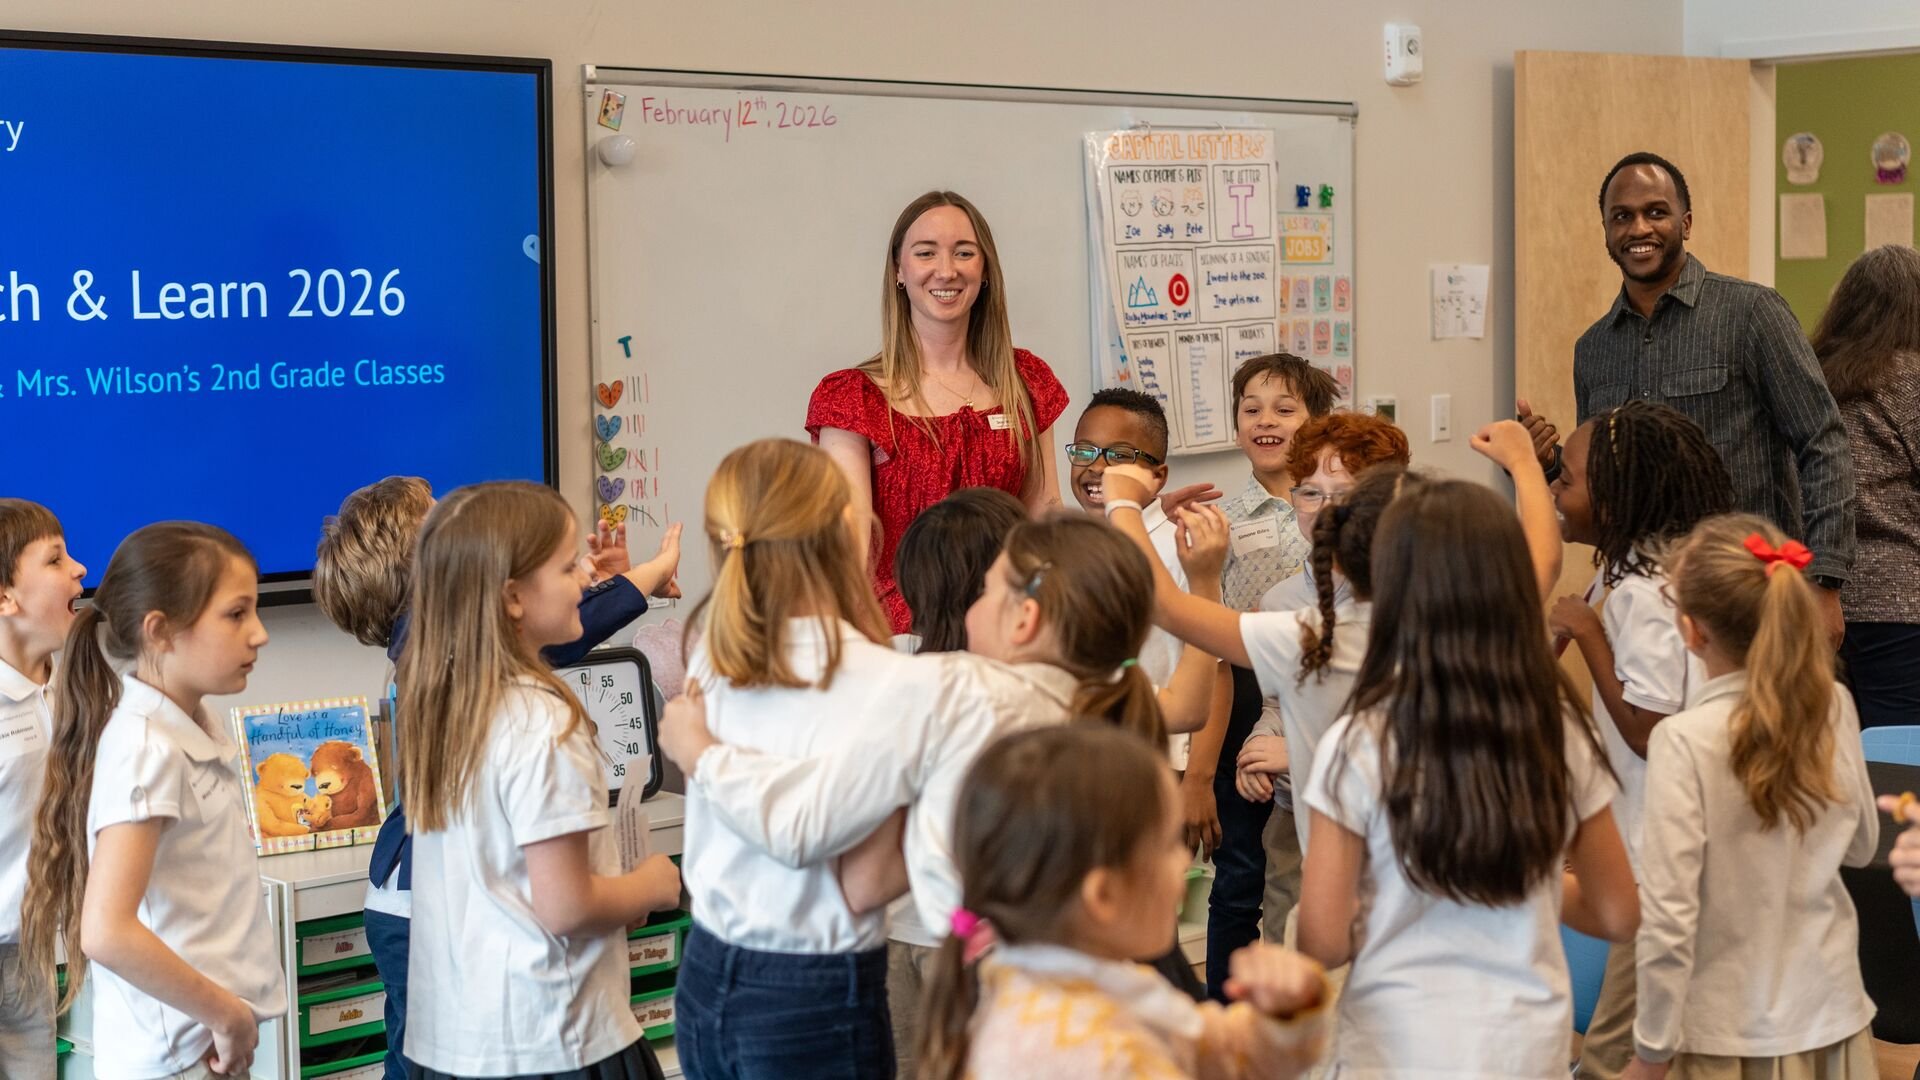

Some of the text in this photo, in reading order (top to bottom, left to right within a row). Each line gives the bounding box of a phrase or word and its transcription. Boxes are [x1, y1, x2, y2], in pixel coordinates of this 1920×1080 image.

[641, 96, 732, 143] February
[777, 102, 838, 129] 2026
[1109, 133, 1265, 160] CAPITAL LETTERS
[1125, 224, 1141, 236] Joe
[1186, 222, 1204, 235] Pete
[1286, 239, 1320, 257] JOBS
[66, 269, 109, 322] &
[131, 269, 268, 320] Learn
[288, 267, 406, 318] 2026
[16, 367, 78, 398] Mrs.
[85, 364, 201, 396] Wilson’s
[210, 363, 261, 391] 2nd
[270, 360, 346, 389] Grade
[354, 358, 445, 386] Classes
[601, 674, 614, 688] 55
[620, 691, 633, 705] 50
[278, 706, 329, 726] Love is a
[629, 716, 642, 730] 45
[250, 722, 364, 746] Handful of Honey
[626, 742, 639, 755] 40
[613, 764, 626, 778] 35
[644, 948, 667, 959] Things
[648, 1008, 672, 1019] Things
